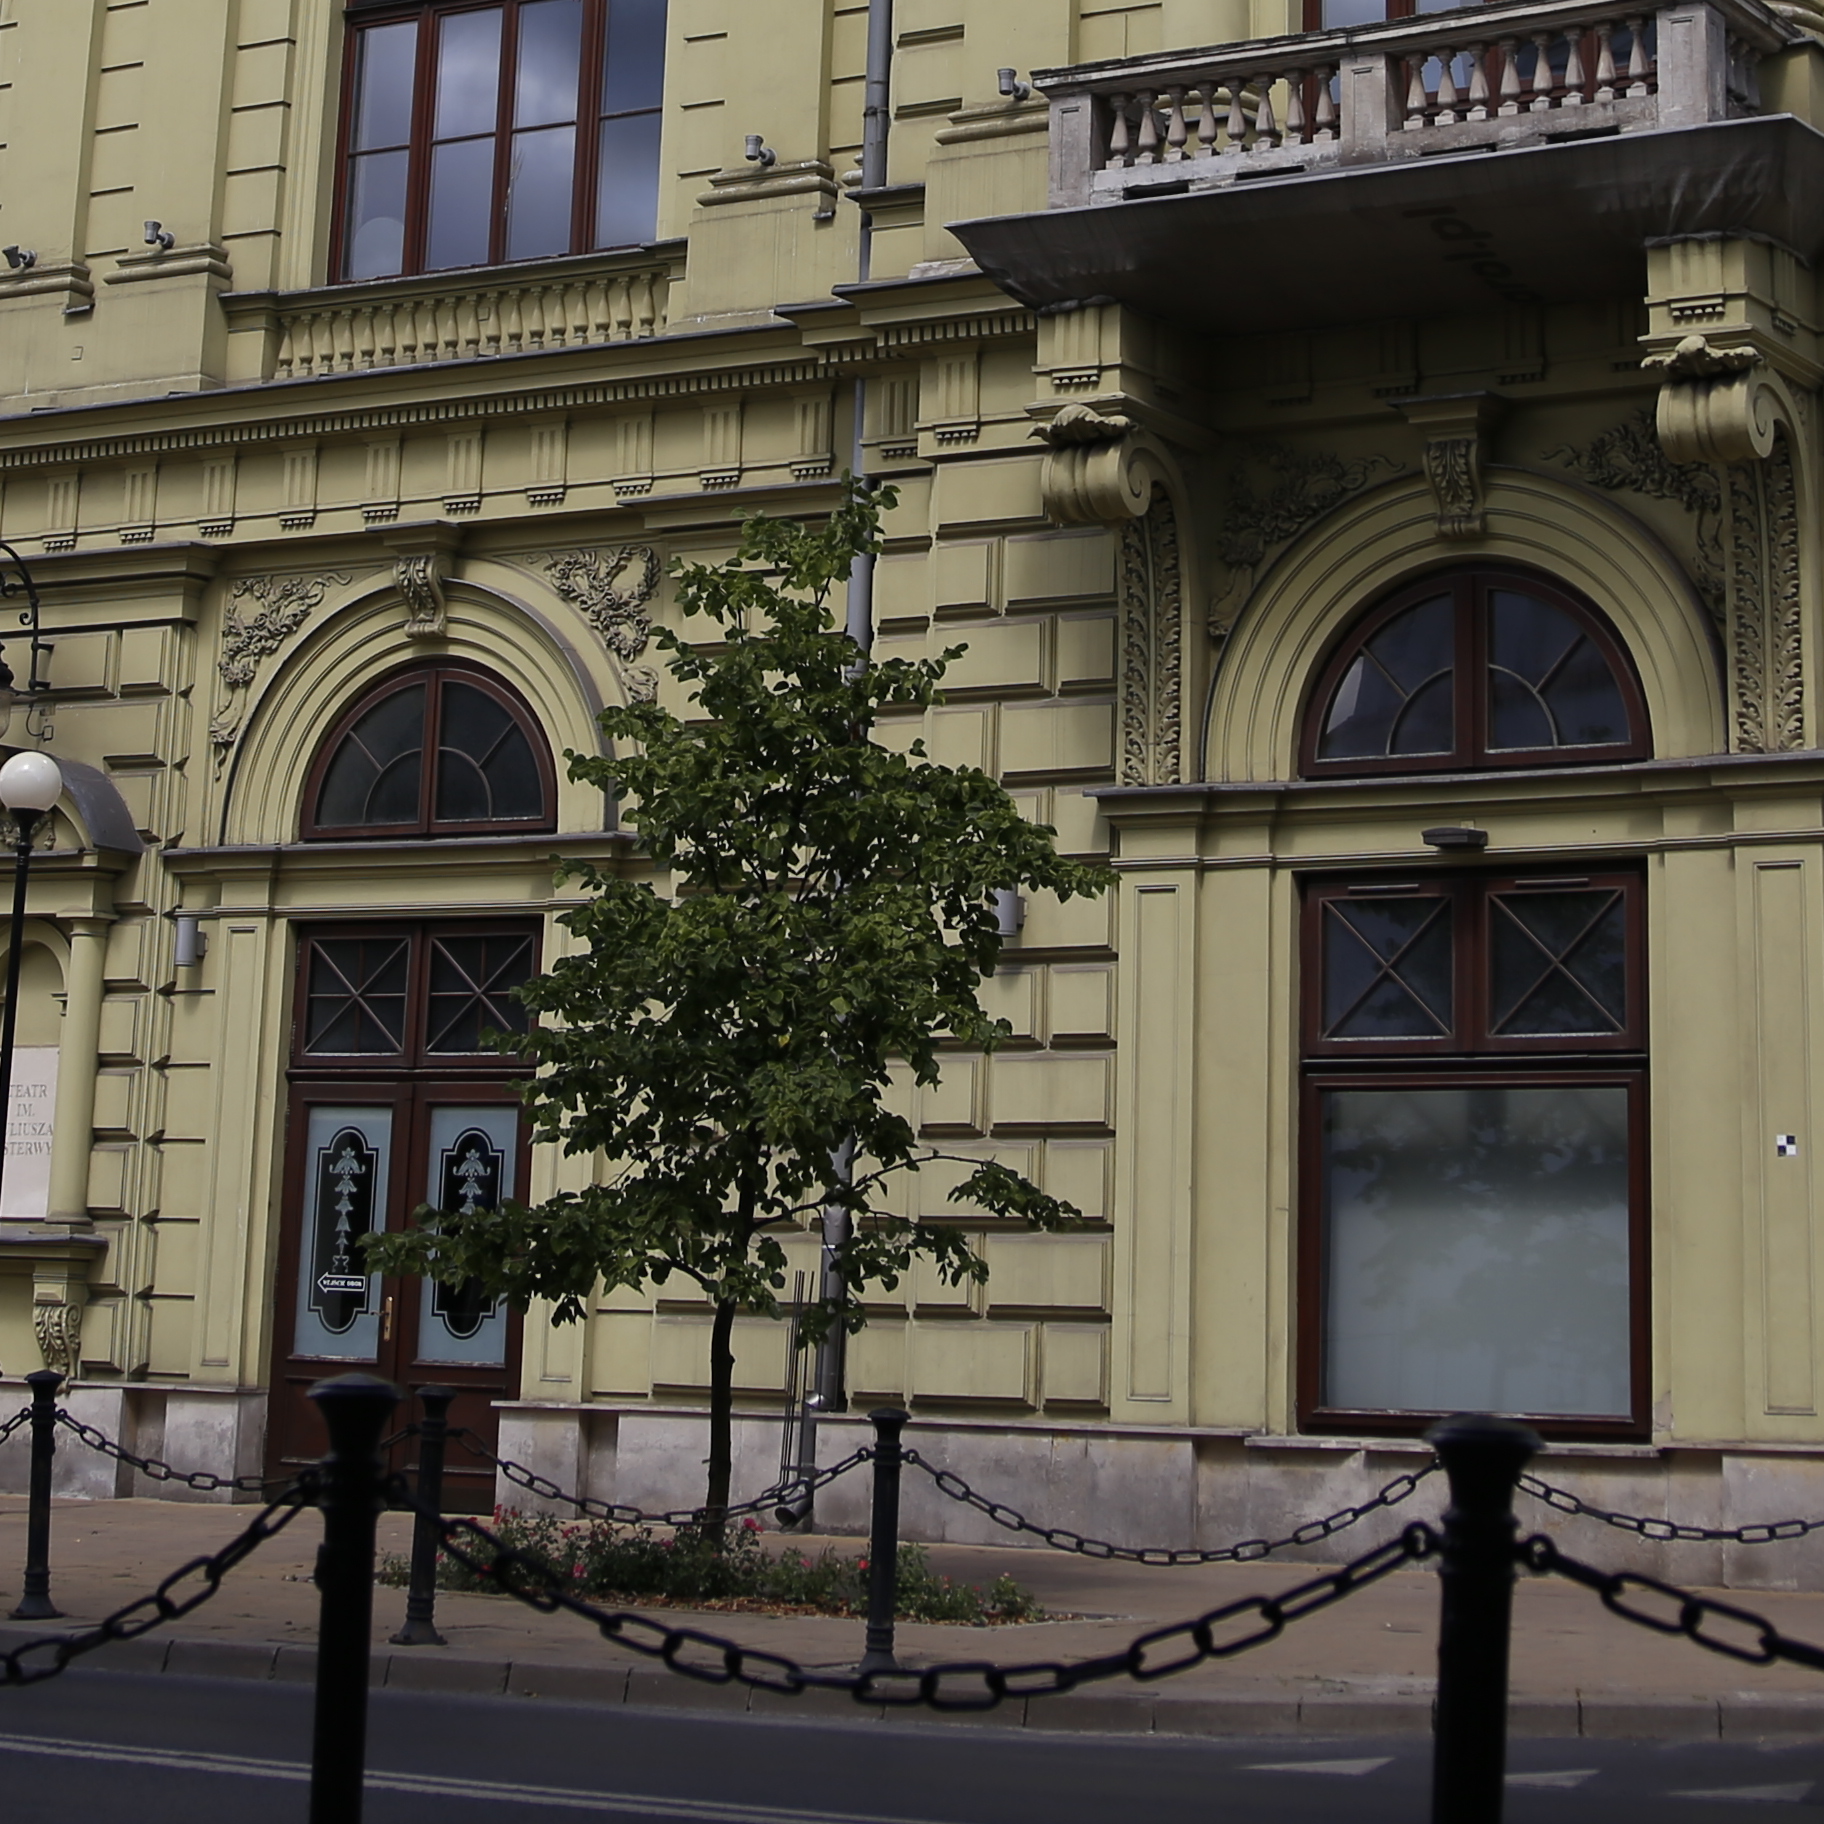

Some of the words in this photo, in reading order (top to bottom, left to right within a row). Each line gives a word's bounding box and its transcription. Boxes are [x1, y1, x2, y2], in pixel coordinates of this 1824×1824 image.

[9, 1084, 47, 1098] TEATR
[17, 1103, 35, 1117] IM.
[4, 1141, 52, 1155] STERWY
